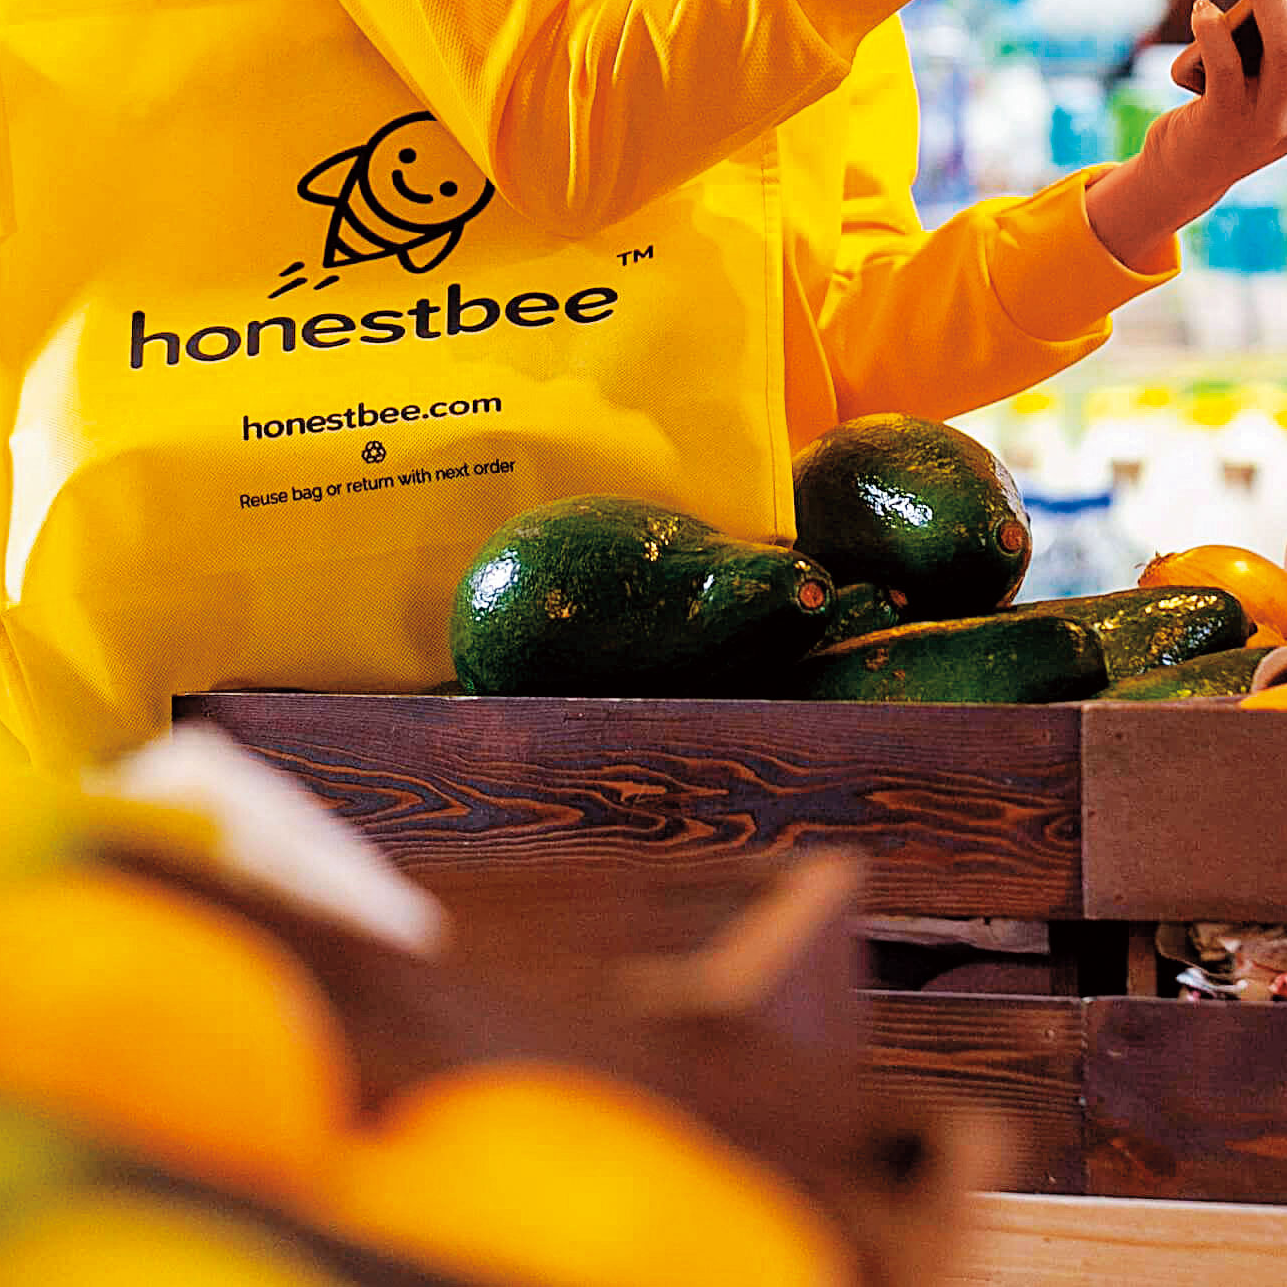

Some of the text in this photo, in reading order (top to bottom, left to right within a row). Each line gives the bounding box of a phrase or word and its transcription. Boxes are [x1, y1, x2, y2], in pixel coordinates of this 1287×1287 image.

[130, 245, 654, 370] honestbee TM
[242, 397, 502, 441] honestbee.com
[239, 456, 516, 509] Reuse bag or return with next order
